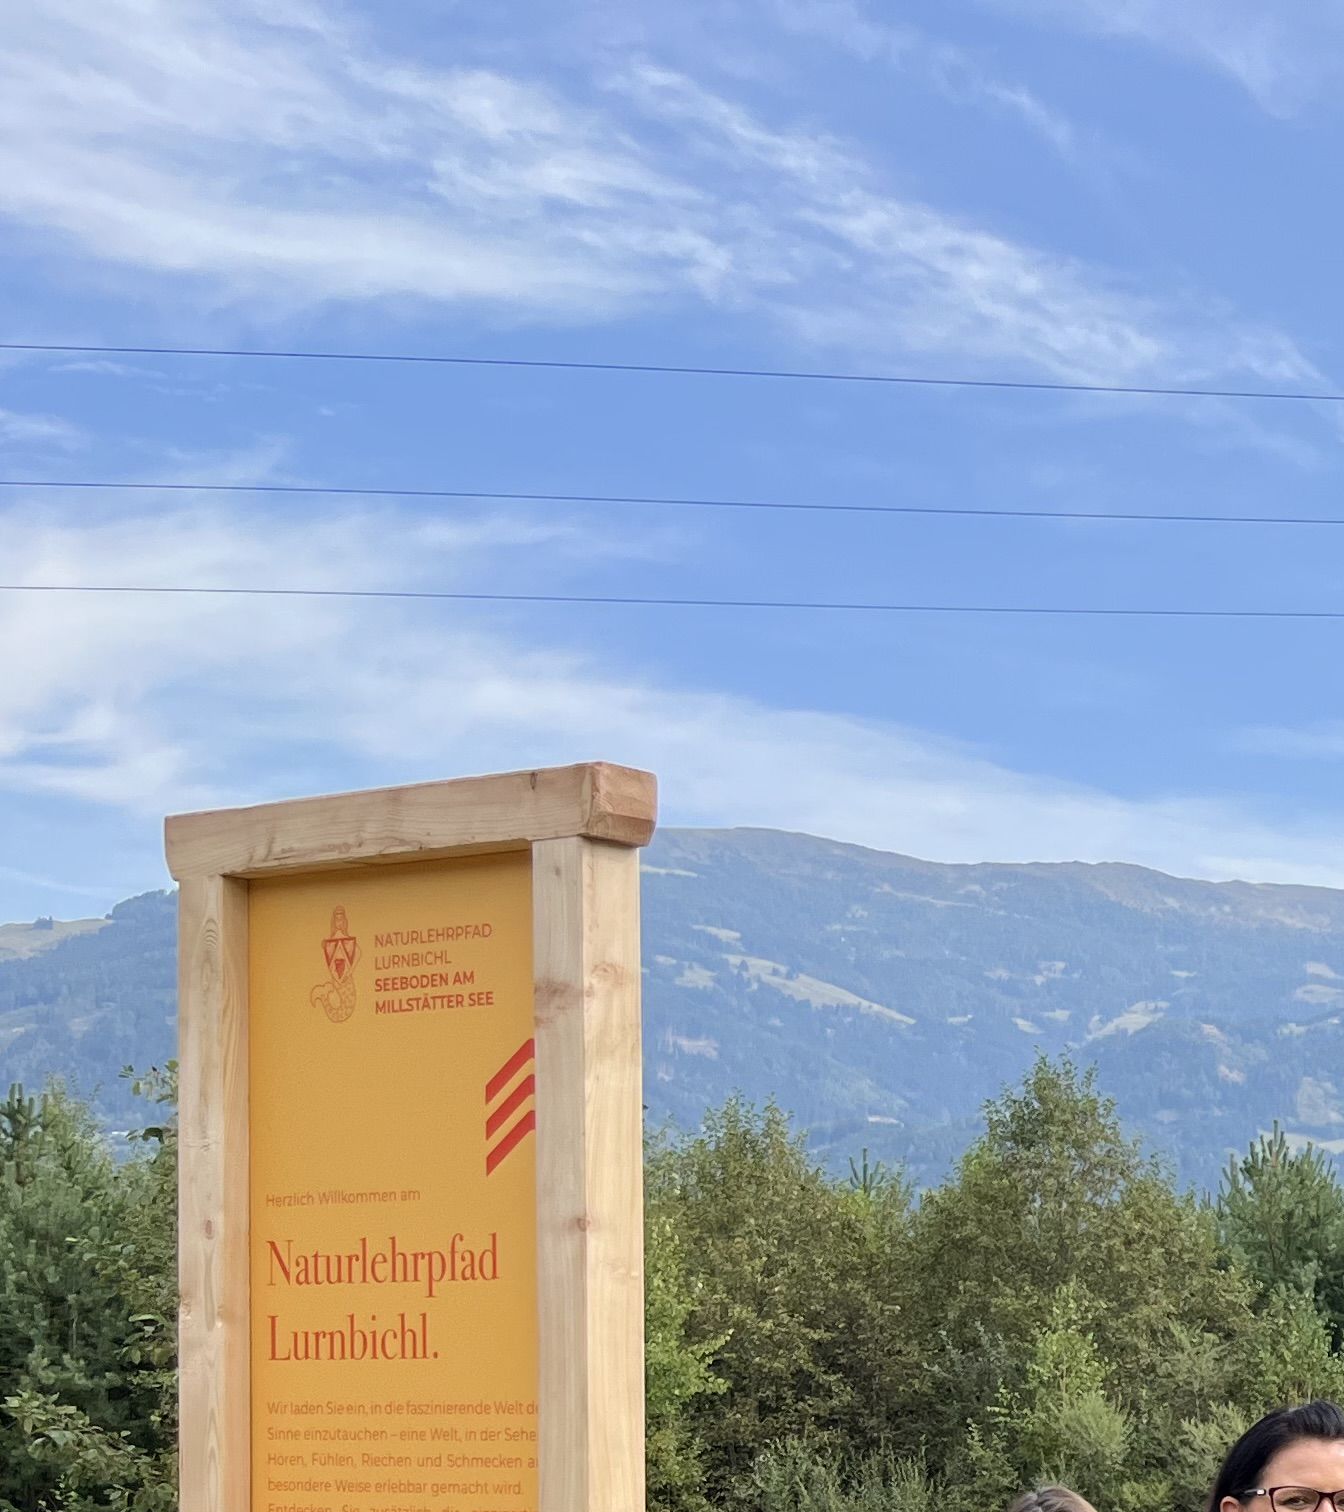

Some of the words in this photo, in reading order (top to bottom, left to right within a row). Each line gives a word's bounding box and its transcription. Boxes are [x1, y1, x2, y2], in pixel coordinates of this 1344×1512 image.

[374, 923, 492, 948] NATURLEHRPFAD
[374, 950, 452, 971] LURNBICHL
[374, 973, 449, 992] SEEBODEN
[452, 970, 475, 986] AM
[374, 993, 464, 1015] MILLSTÄTTER
[468, 991, 494, 1007] SEE
[266, 1191, 314, 1208] Herzlich
[318, 1189, 397, 1205] Willkommen
[400, 1189, 420, 1202] am
[266, 1231, 501, 1298] Naturlehrpfad
[267, 1312, 439, 1361] Lurnbichl.
[267, 1401, 287, 1415] Wir
[291, 1401, 324, 1415] laden
[326, 1402, 344, 1415] Sie
[370, 1402, 382, 1415] in
[384, 1401, 406, 1415] die
[407, 1401, 491, 1416] faszinierende
[494, 1401, 524, 1415] Welt
[267, 1427, 300, 1441] Sinne
[303, 1427, 388, 1442] einzutauchen
[399, 1428, 426, 1441] eine
[465, 1428, 476, 1441] in
[480, 1428, 502, 1442] der
[504, 1427, 538, 1442] Sehe
[361, 1453, 412, 1467] Riechen
[417, 1454, 442, 1468] und
[447, 1454, 522, 1469] Schmecken
[267, 1478, 332, 1492] besondere
[335, 1479, 371, 1493] Weise
[374, 1480, 427, 1494] erlebbar
[431, 1481, 489, 1497] gemacht
